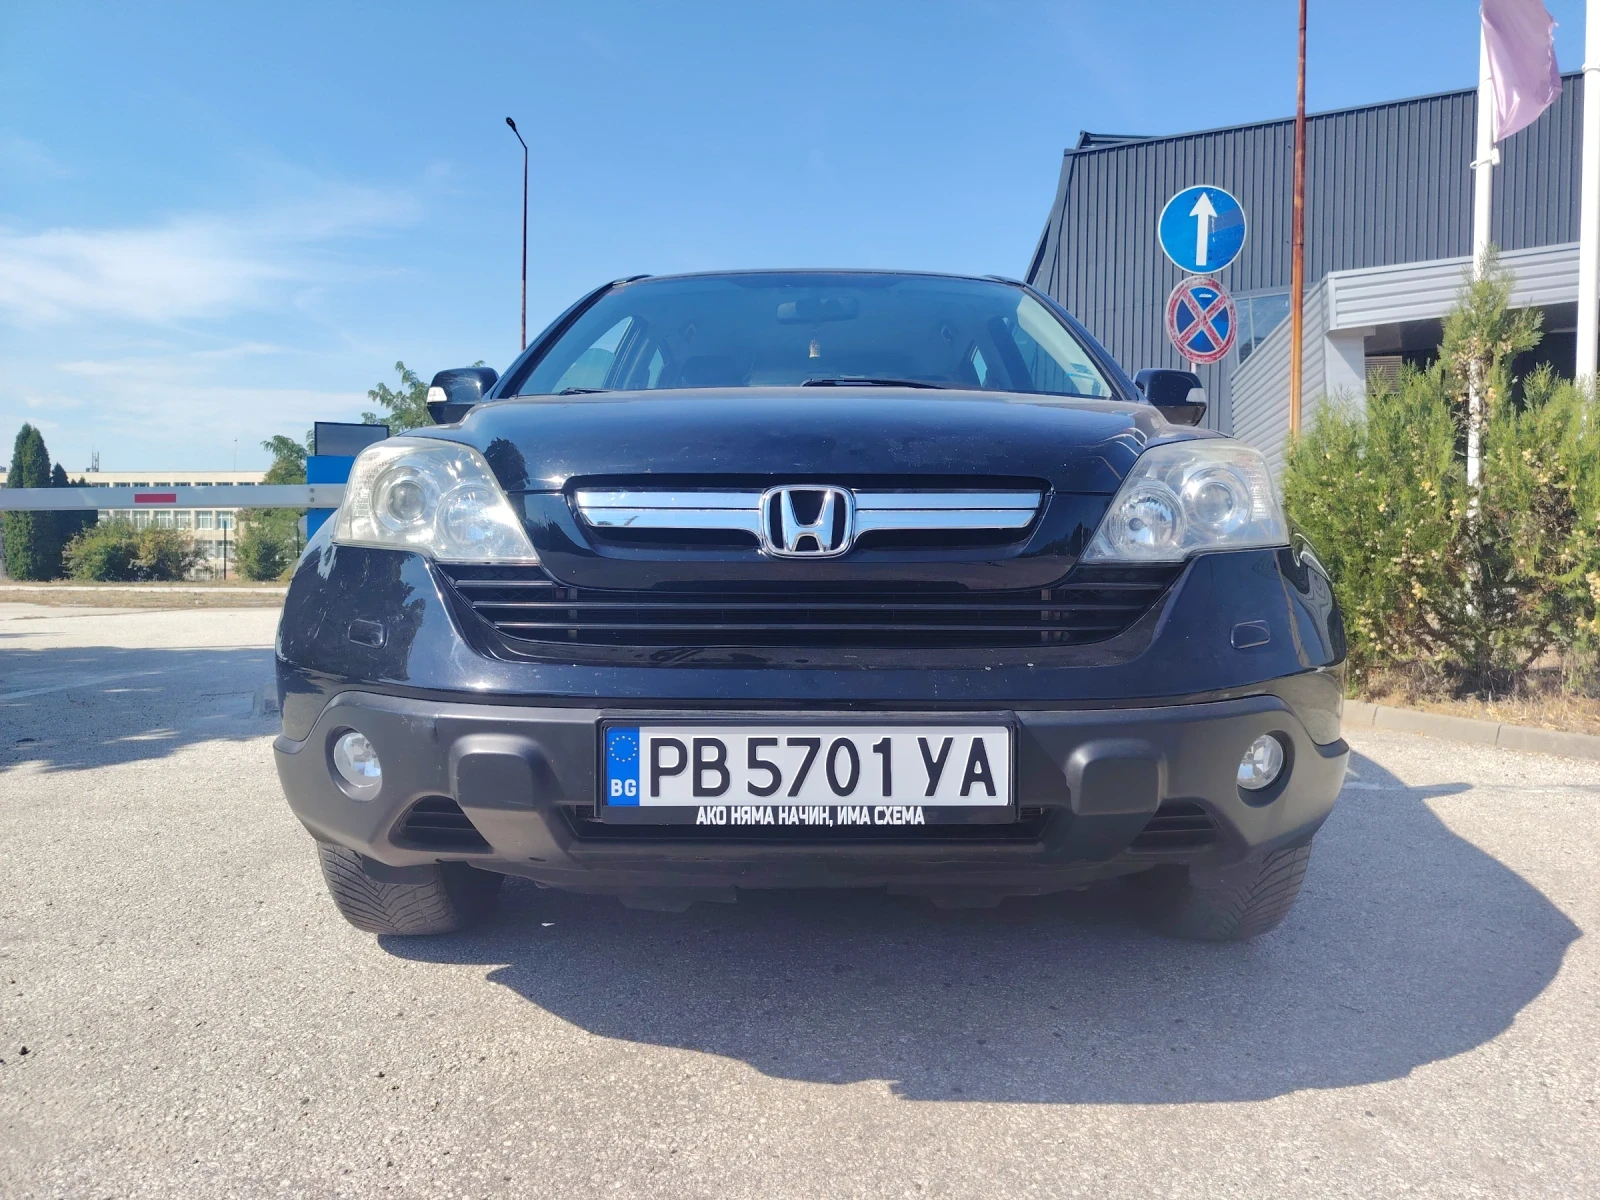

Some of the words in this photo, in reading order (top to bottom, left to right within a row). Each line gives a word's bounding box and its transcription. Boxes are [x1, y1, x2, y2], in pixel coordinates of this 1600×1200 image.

[649, 737, 731, 798] PB
[747, 737, 893, 798] 5701
[916, 737, 998, 798] YA
[610, 778, 638, 797] BG
[696, 806, 727, 825] АКО
[730, 806, 775, 825] НЯМА
[778, 806, 834, 828] НАЧИН,
[837, 806, 871, 825] ИМА
[874, 806, 926, 825] СХЕМА
